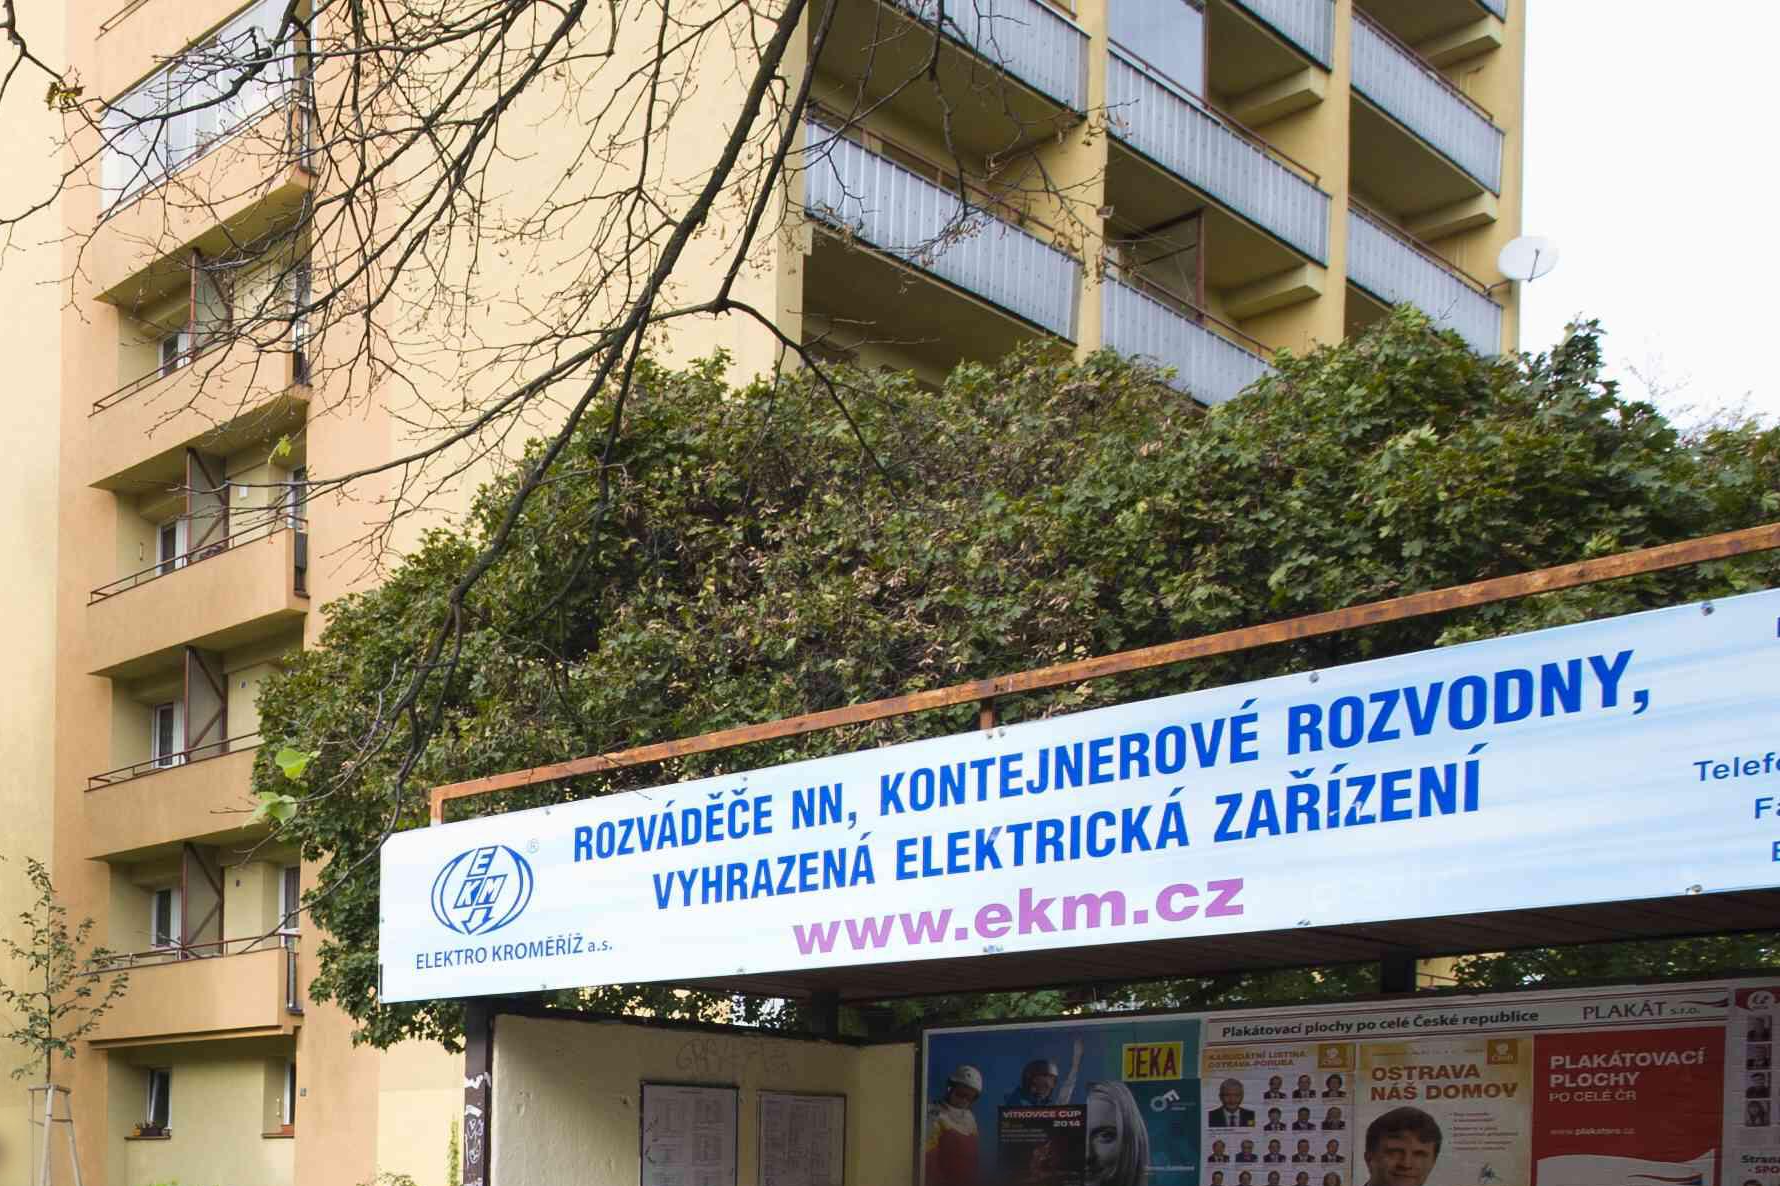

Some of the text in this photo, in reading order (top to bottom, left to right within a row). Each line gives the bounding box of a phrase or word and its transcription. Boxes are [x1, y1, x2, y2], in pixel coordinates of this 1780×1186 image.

[574, 650, 1650, 862] ROZVÁDĚČE NN, KONTEJNEROVÉ ROZVODNY,
[653, 742, 1489, 909] VYHRAZENÁ ELEKTRICKÁ ZAŘÍZENÍ
[793, 877, 1245, 956] www.ekm.cz
[415, 935, 613, 970] ELEKTRO KROMĚŘÍŽ a.s.
[1583, 1000, 1667, 1020] PLAKÁT
[1222, 1009, 1540, 1038] Plakátovací plochy po celé České republice
[1126, 1046, 1177, 1079] JEKA
[1550, 1047, 1707, 1069] PLAKÁTOVACÍ
[1371, 1064, 1481, 1082] OSTRAVA
[1550, 1071, 1640, 1088] PLOCHY
[1371, 1081, 1518, 1101] NÁŠ DOMOV
[1549, 1088, 1637, 1102] PO CELÉ ČR
[1053, 1120, 1081, 1128] 2014
[1059, 1109, 1082, 1118] CUP
